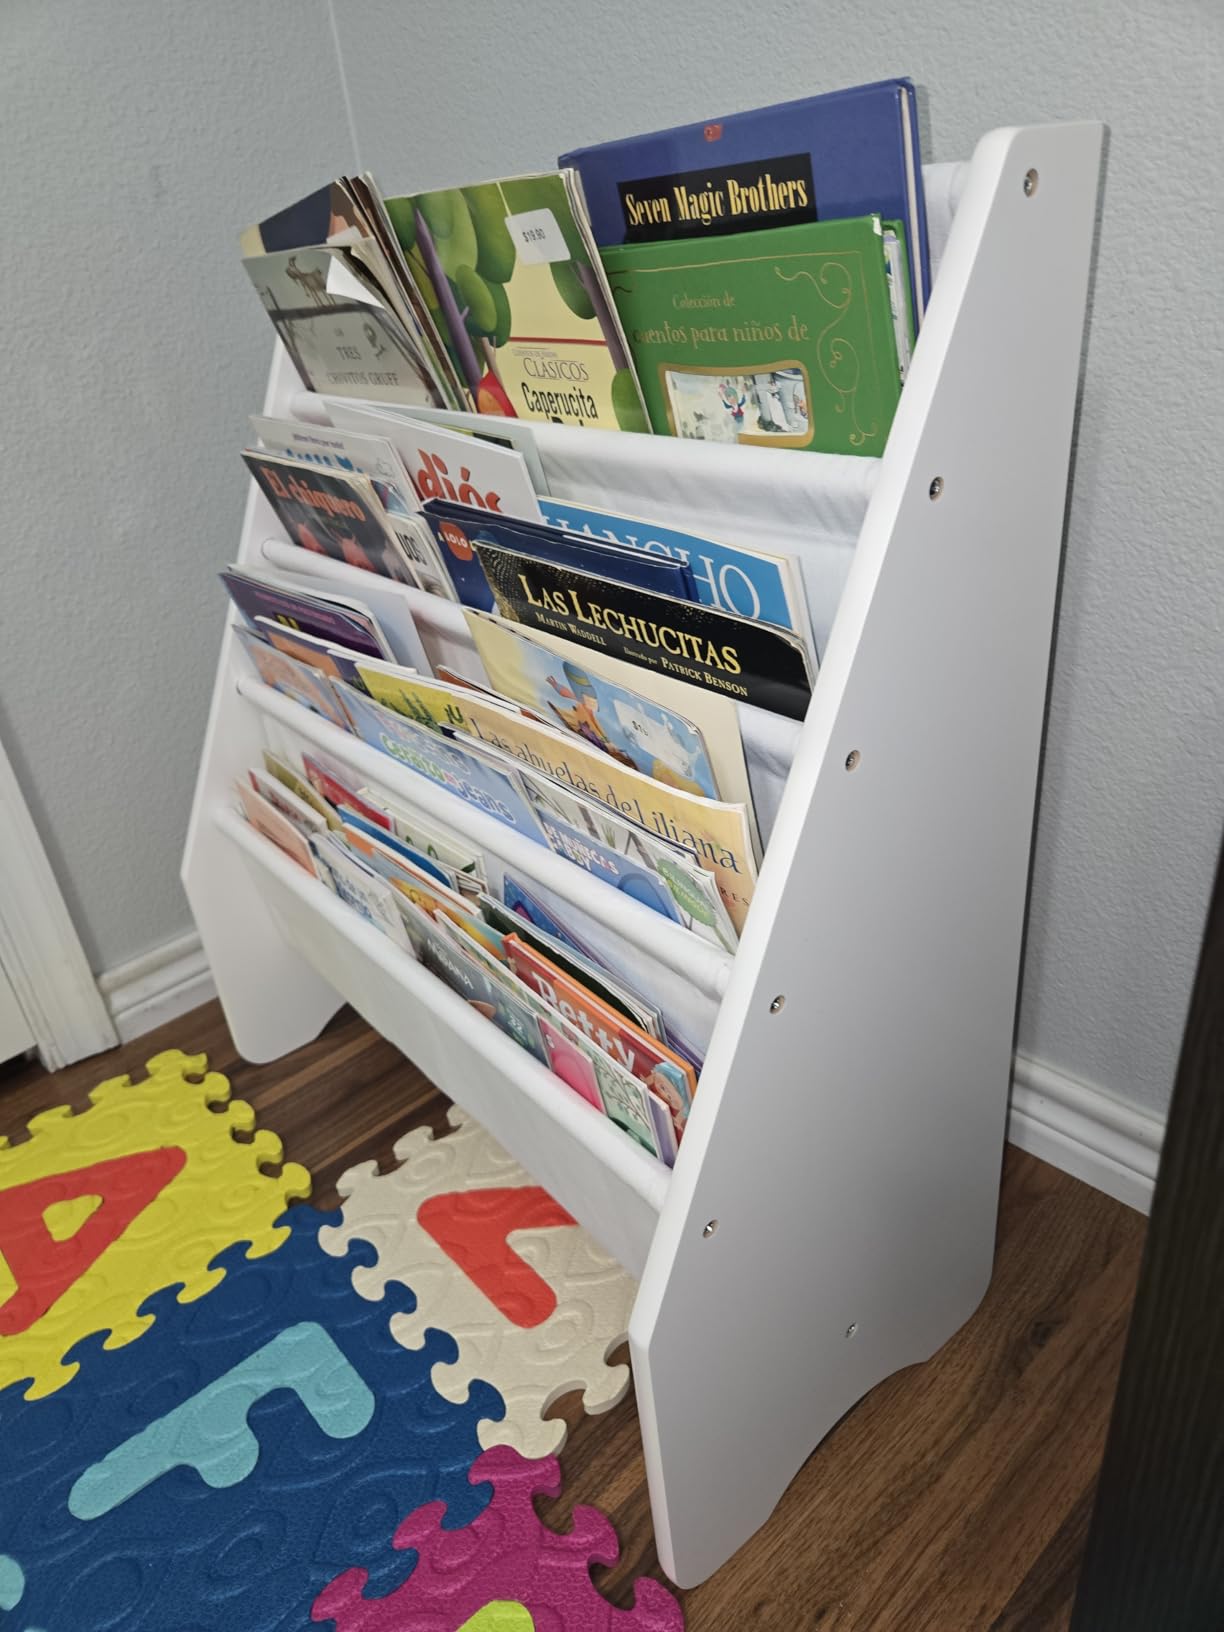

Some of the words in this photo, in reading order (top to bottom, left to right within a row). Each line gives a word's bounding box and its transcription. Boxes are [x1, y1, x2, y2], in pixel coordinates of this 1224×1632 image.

[626, 193, 672, 226] Seven
[673, 181, 725, 226] Magic
[726, 173, 809, 216] Brothers
[723, 290, 736, 307] de
[690, 326, 729, 350] para
[732, 319, 784, 343] niños
[787, 314, 810, 342] de
[522, 356, 590, 381] CLÁSICOS
[520, 381, 599, 420] Caperucita
[517, 573, 570, 617] LAS
[567, 589, 742, 676] LECHUCITAS
[535, 611, 568, 632] MARTIN
[568, 622, 608, 647] WADDELL
[660, 656, 703, 681] PATRICK
[702, 671, 749, 698] BENSON
